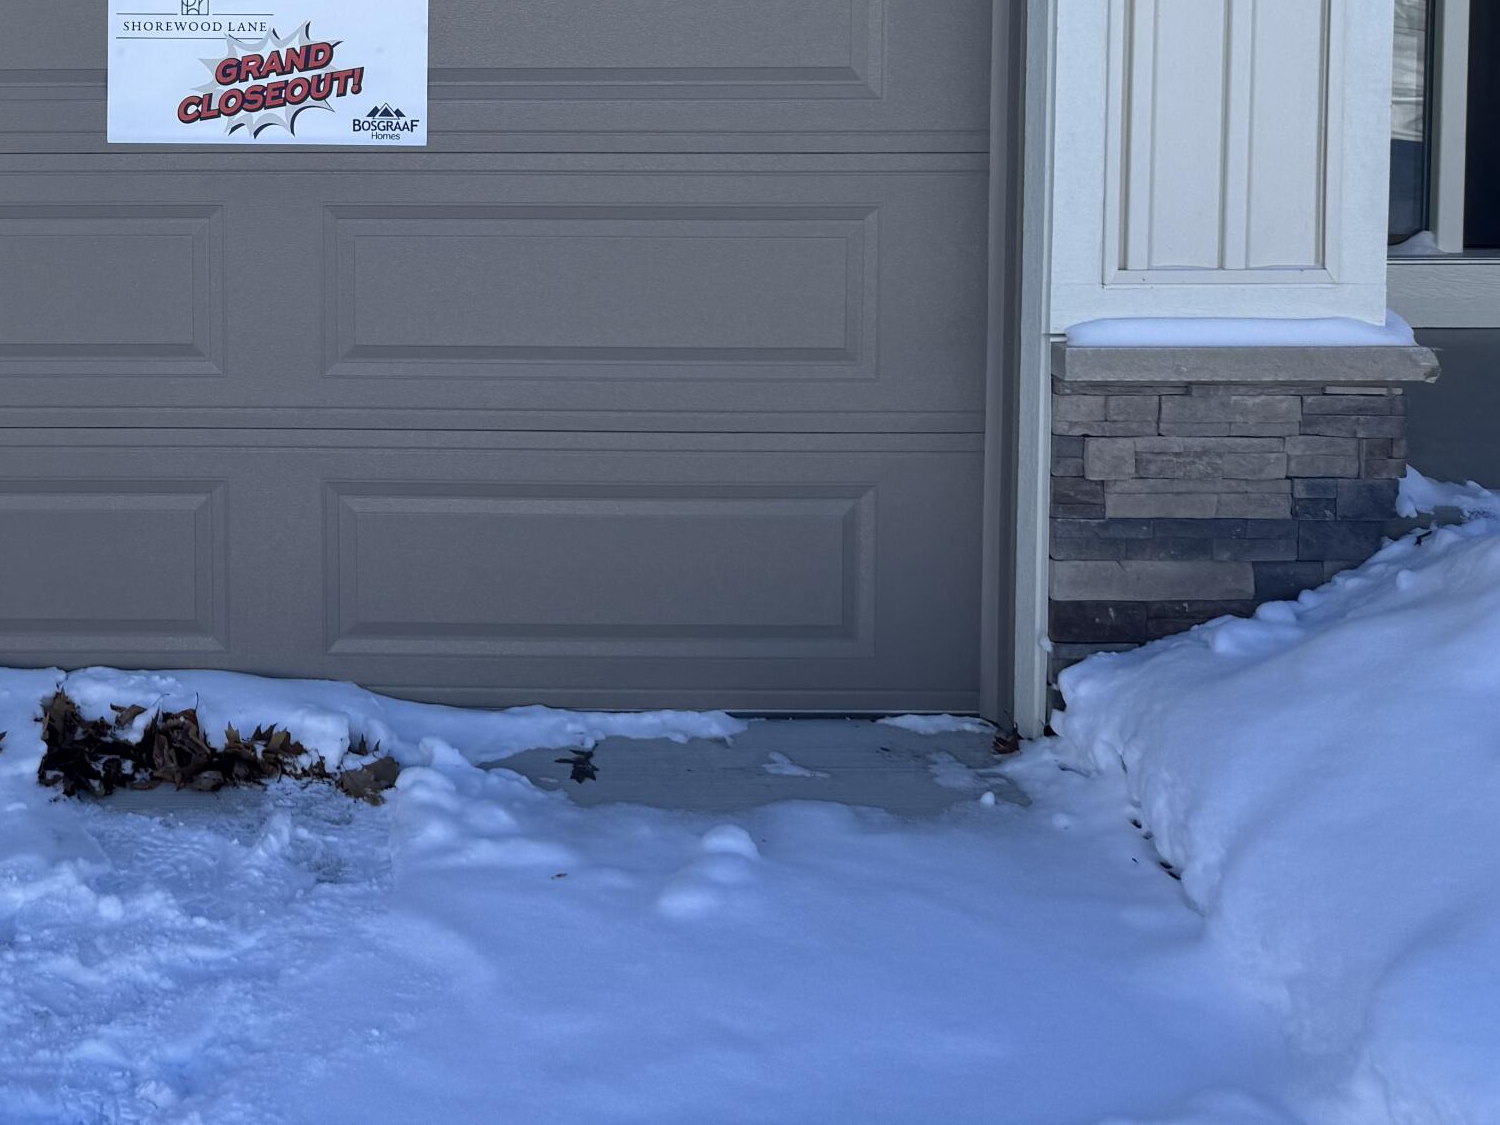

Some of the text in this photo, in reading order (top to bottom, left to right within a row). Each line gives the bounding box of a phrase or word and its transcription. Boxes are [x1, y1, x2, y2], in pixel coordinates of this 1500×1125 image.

[123, 21, 267, 32] SHOREWOOD LANE
[215, 42, 334, 85] GRAND
[177, 67, 364, 124] CLOSEOUT!
[352, 119, 420, 133] BOSGRAAF
[371, 132, 400, 140] Homes
